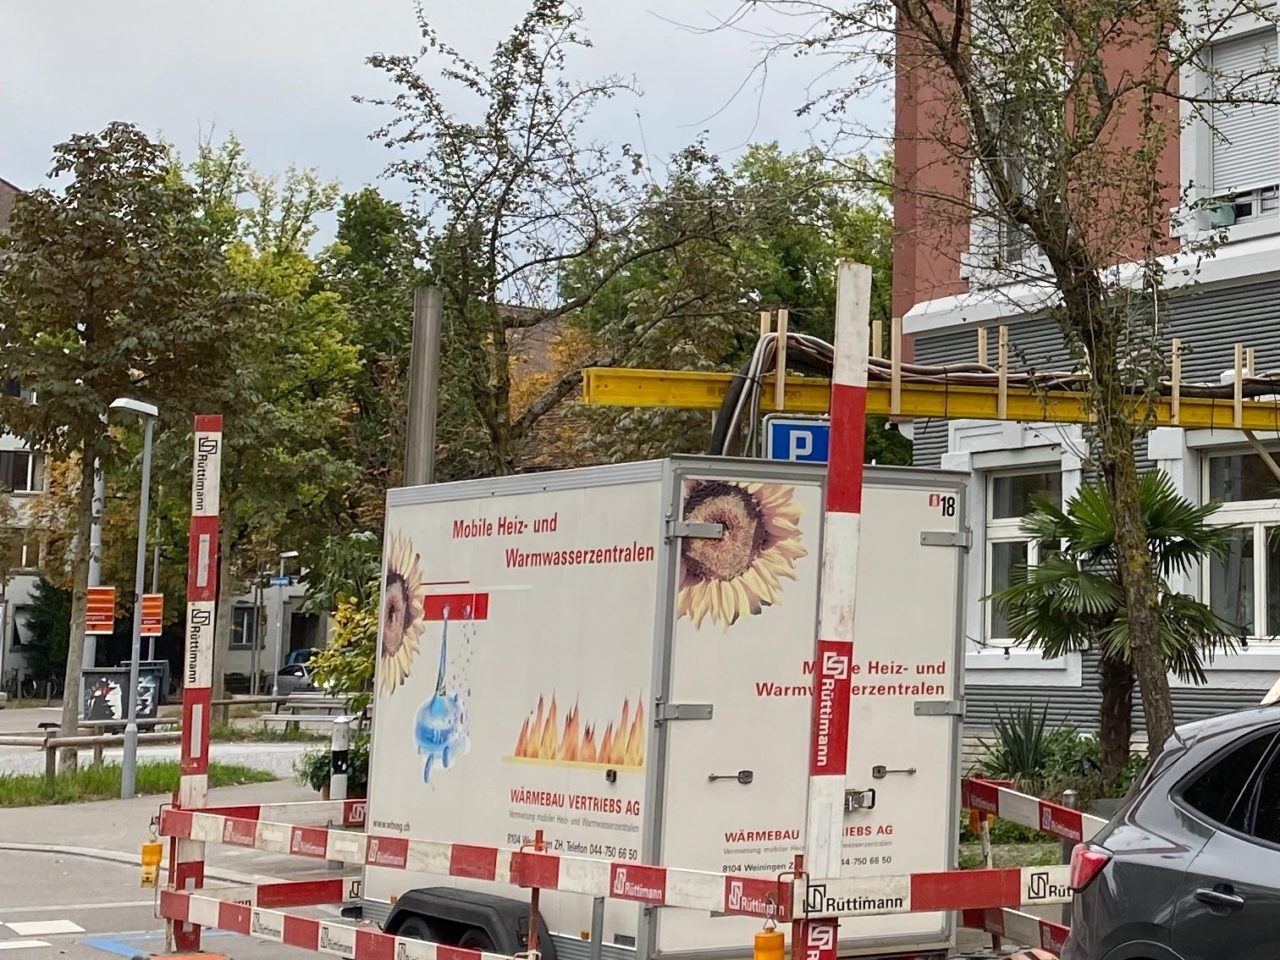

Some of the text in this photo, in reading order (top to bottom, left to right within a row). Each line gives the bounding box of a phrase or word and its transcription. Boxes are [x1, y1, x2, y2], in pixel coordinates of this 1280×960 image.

[789, 430, 813, 462] P
[195, 454, 208, 511] Rüttimann
[941, 495, 955, 517] 18
[453, 512, 558, 539] Mobile Heiz- und
[505, 541, 655, 569] Warmwasserzentralen
[188, 625, 201, 684] Rüttimann
[868, 661, 908, 675] Heiz-
[916, 661, 946, 675] und
[816, 678, 836, 767] Rüttimann
[510, 786, 640, 816] WÄRMEBAU VERTRIEBS AG
[724, 829, 800, 843] WÄRMEBAU
[876, 825, 893, 836] AG
[722, 864, 742, 874] 8104
[744, 861, 787, 873] Weiningen
[853, 857, 868, 866] 750
[869, 856, 880, 865] 66
[881, 856, 892, 864] 50
[624, 881, 663, 901] Rüttimann
[826, 896, 903, 912] Rüttimann
